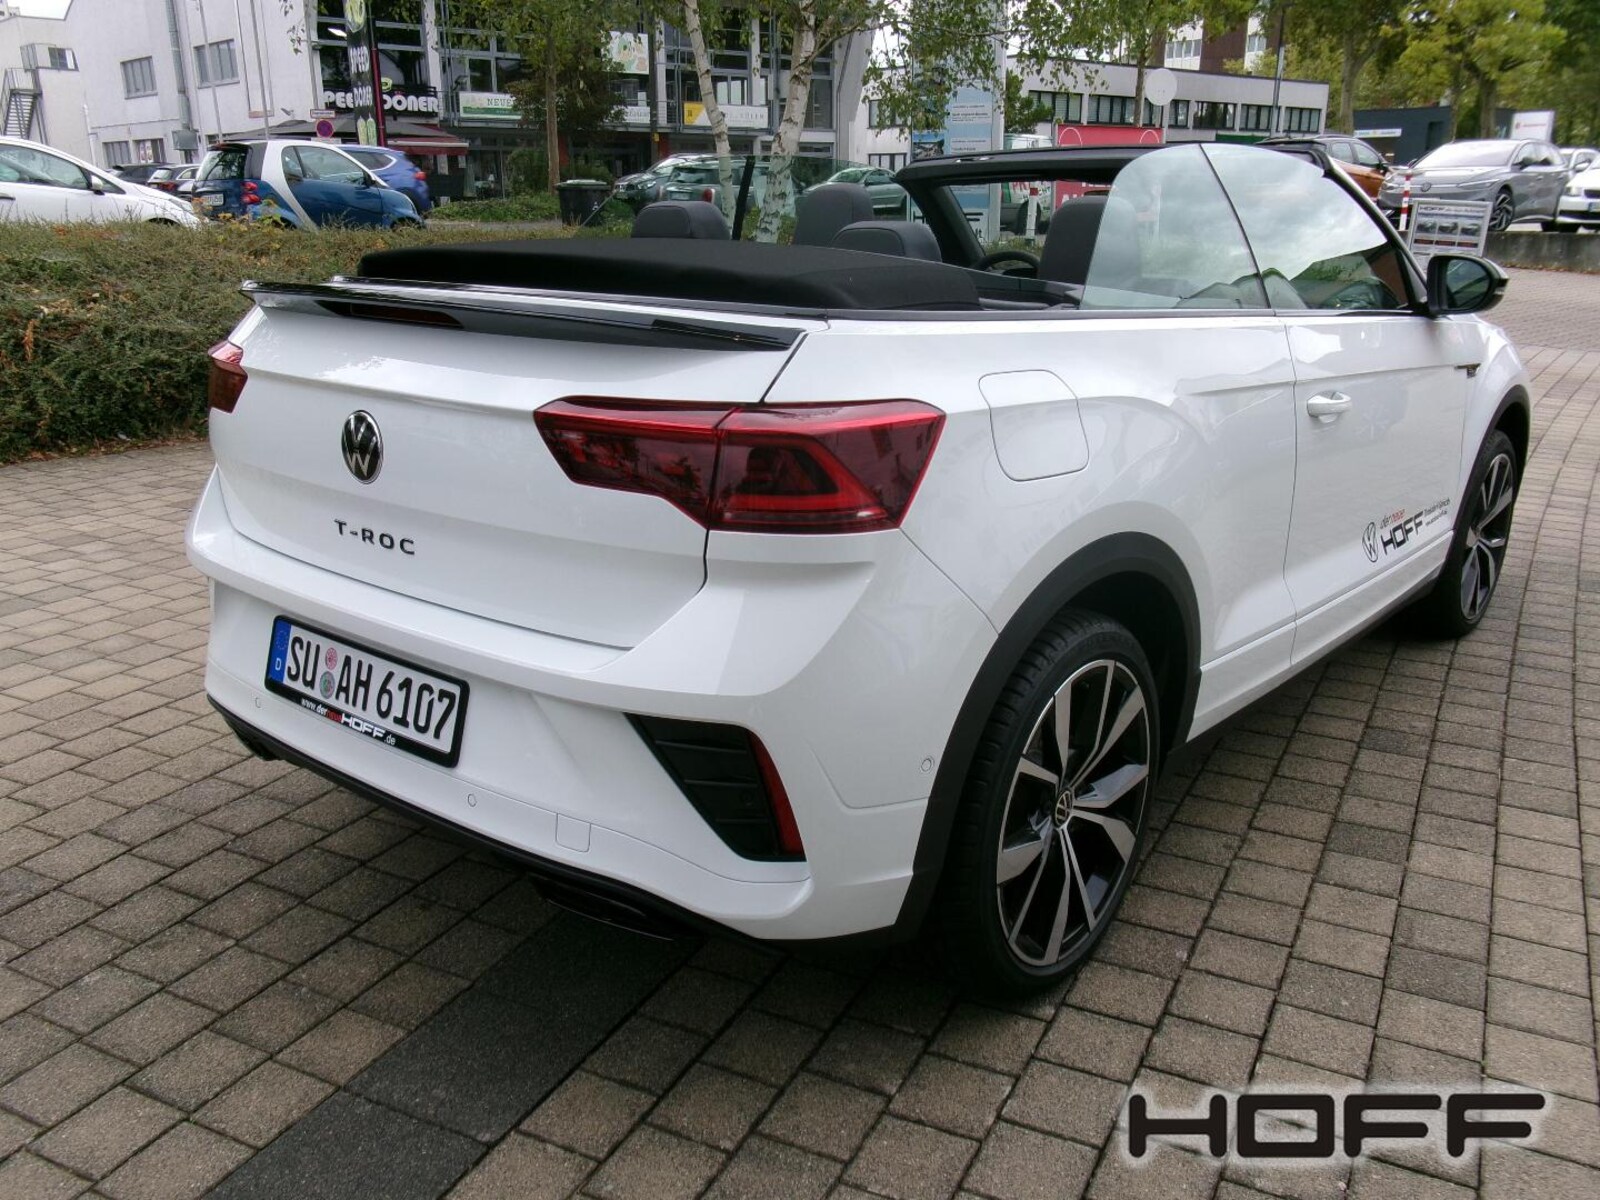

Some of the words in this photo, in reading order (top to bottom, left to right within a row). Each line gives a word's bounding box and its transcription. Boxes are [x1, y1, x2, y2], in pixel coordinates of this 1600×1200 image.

[334, 519, 416, 555] T-ROC
[1381, 511, 1423, 556] HOFF
[275, 657, 282, 671] D
[287, 636, 320, 690] SU
[335, 655, 373, 712] AH
[376, 671, 457, 739] 6107
